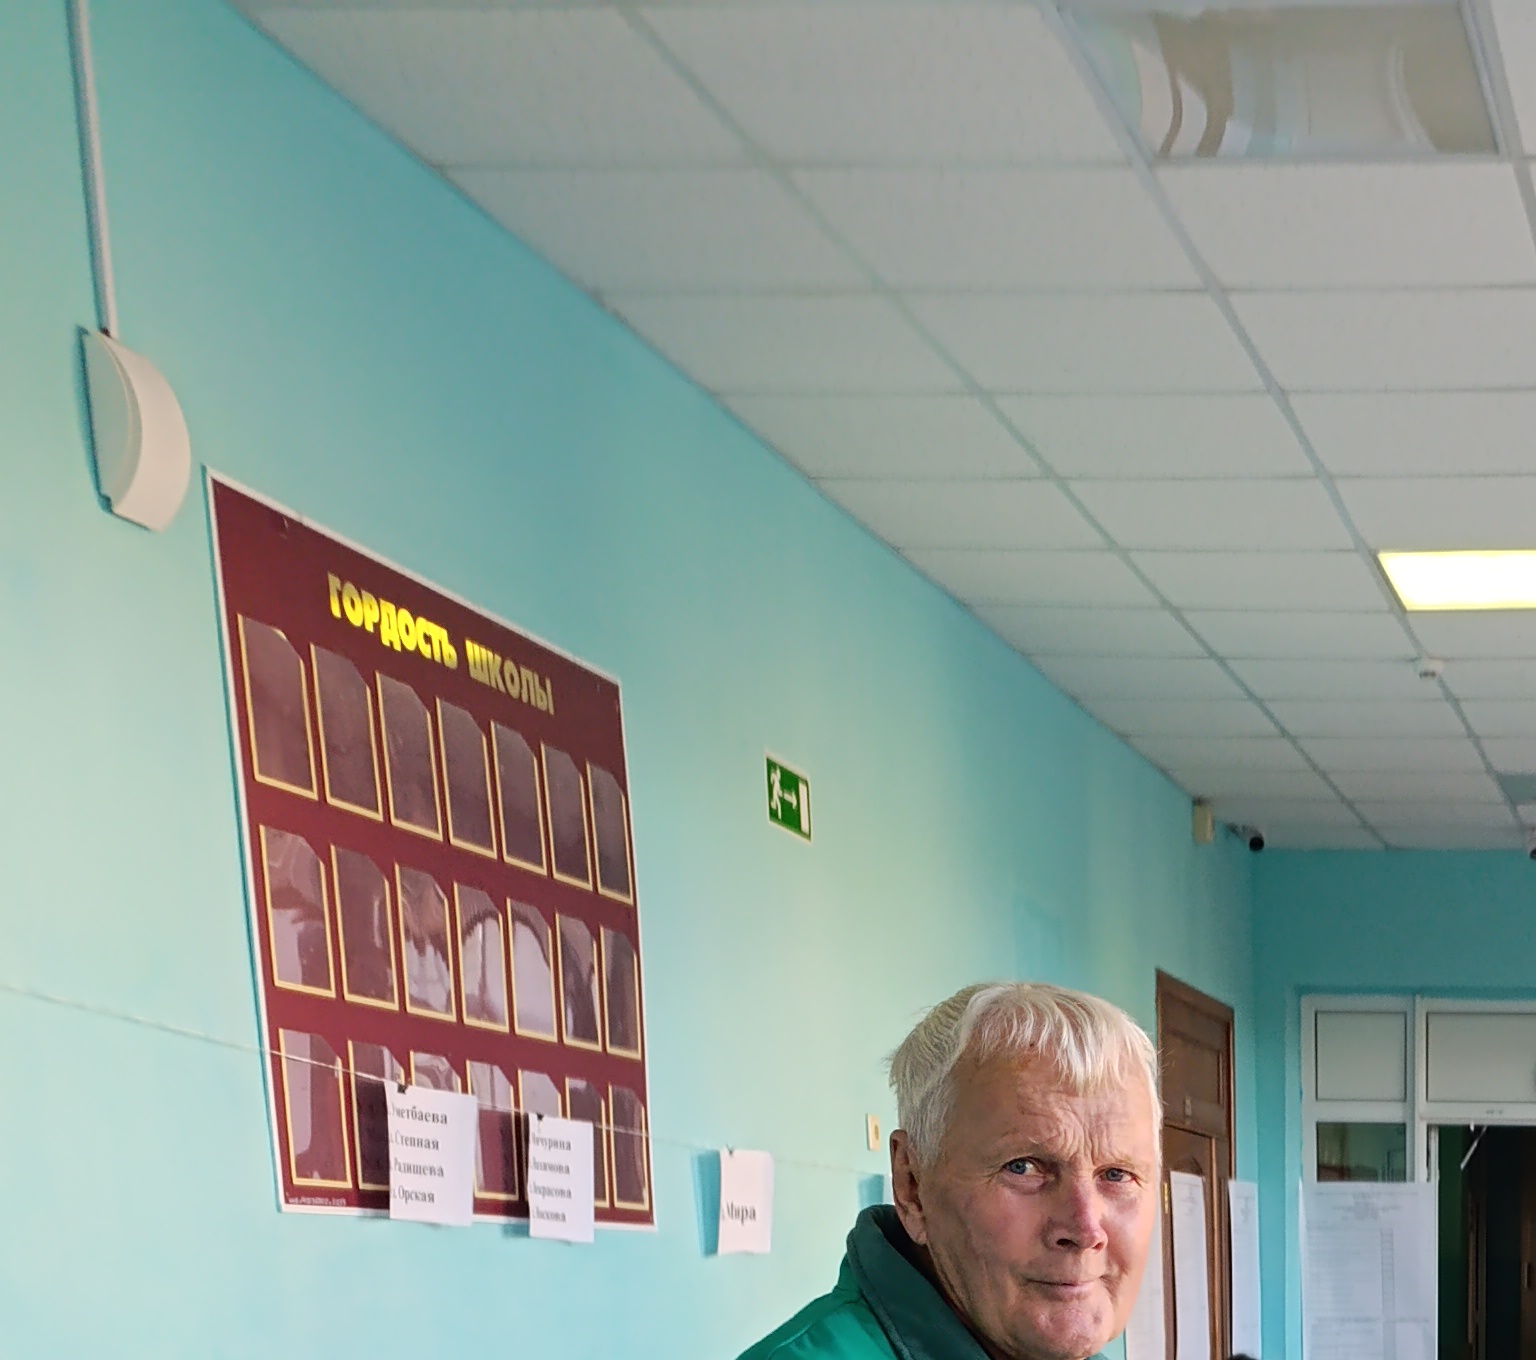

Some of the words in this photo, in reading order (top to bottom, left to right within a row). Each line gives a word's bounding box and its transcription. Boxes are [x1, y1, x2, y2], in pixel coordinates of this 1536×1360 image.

[327, 571, 458, 670] ГОРДОСТЬ
[465, 638, 554, 715] ШКОЛЫ
[395, 1130, 440, 1151] Степная
[398, 1185, 435, 1205] Орская
